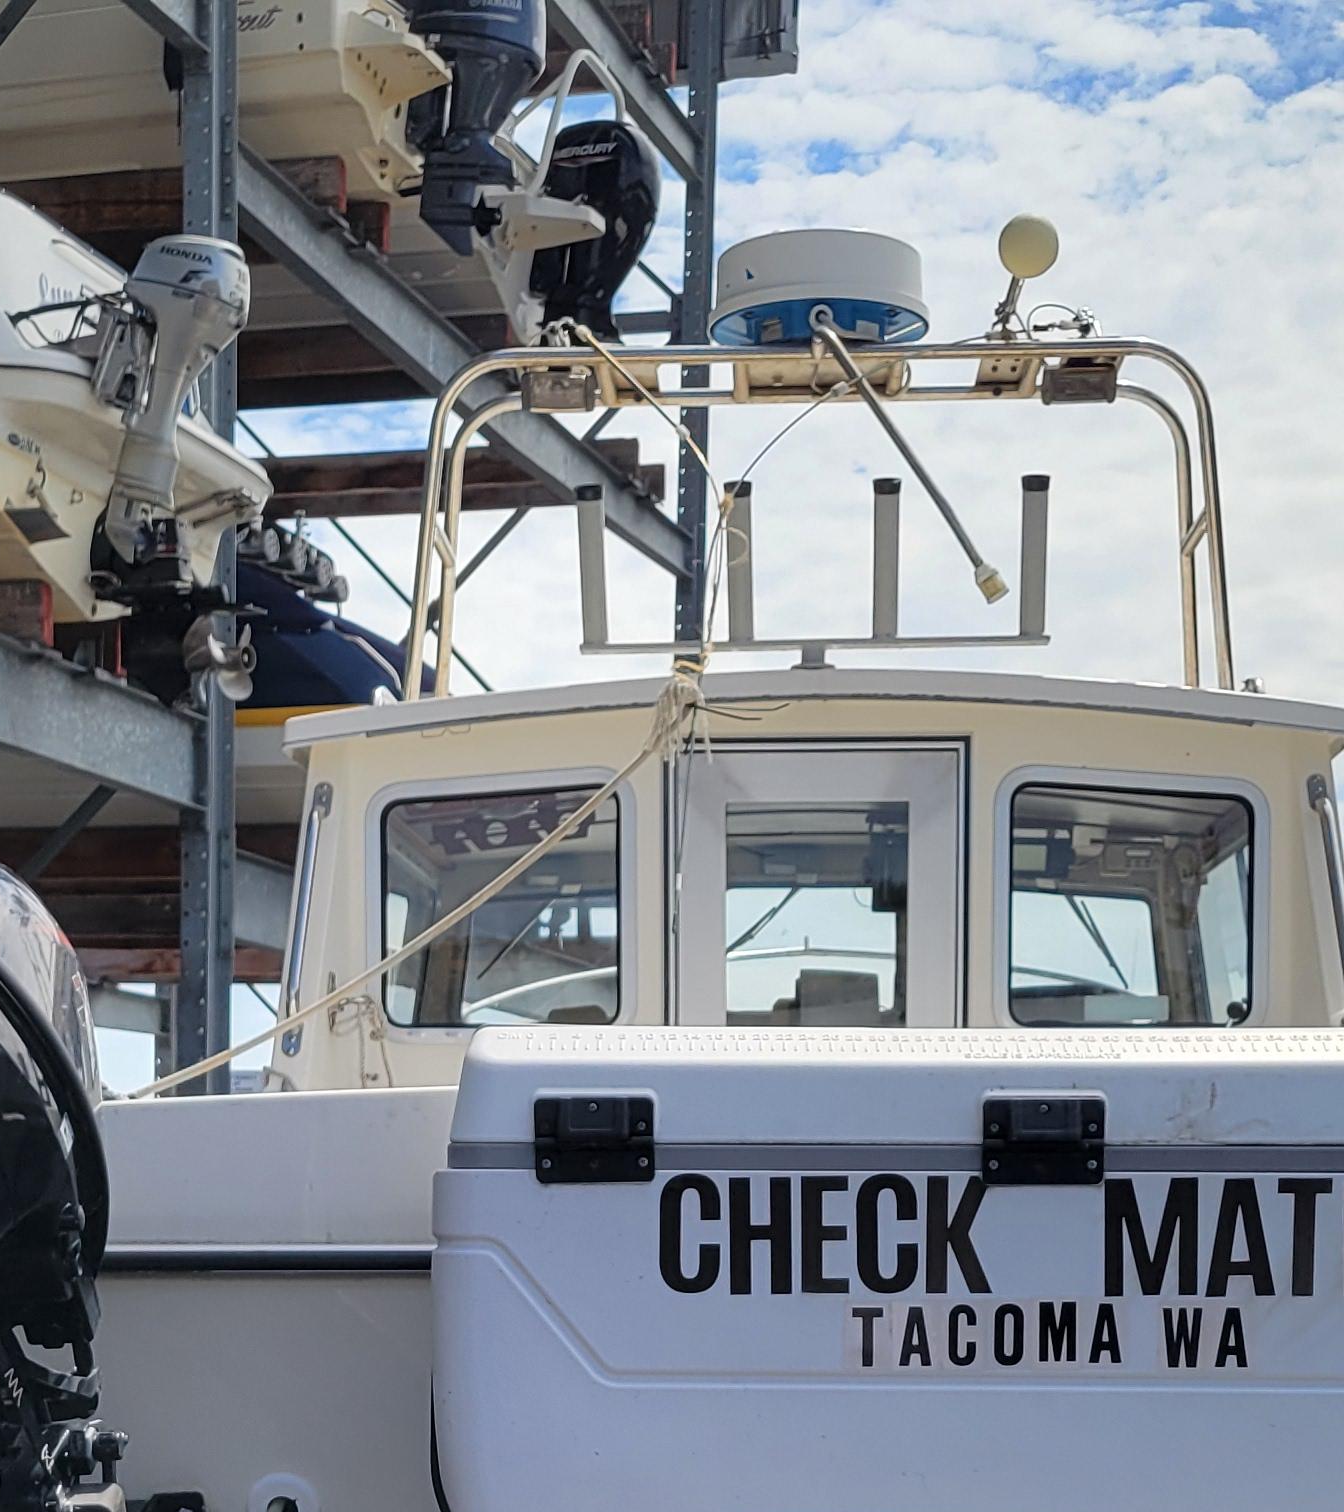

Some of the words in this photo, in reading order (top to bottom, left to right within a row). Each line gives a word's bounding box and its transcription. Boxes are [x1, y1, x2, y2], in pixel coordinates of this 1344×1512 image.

[554, 142, 617, 159] ERCURY
[160, 245, 213, 265] HONDA
[658, 1173, 993, 1295] CHECK
[851, 1302, 1123, 1368] TACOMA
[1161, 1306, 1249, 1368] WA
